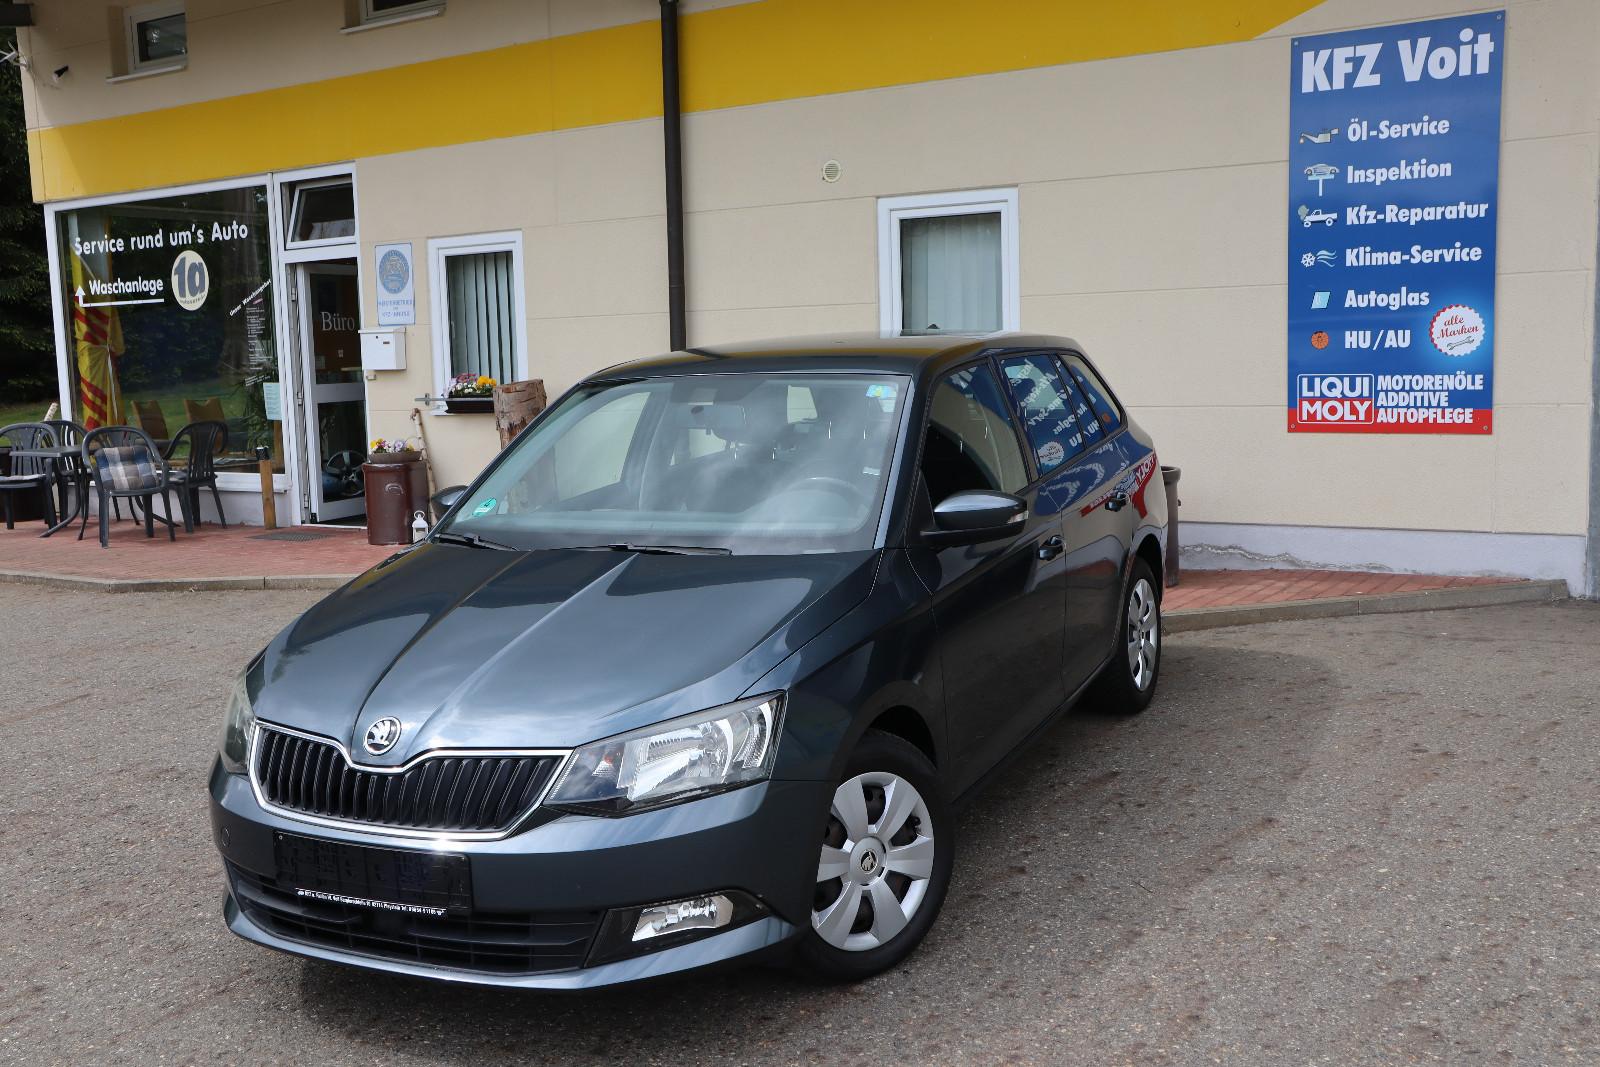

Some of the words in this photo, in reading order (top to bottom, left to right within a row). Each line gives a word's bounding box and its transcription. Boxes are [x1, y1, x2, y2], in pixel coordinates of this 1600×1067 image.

[1301, 42, 1384, 93] KFZ
[1397, 27, 1494, 82] Voit
[1347, 115, 1450, 142] Öl-Service
[1347, 158, 1452, 185] Inspektion
[1346, 201, 1489, 226] Kfz-Reparatur
[74, 234, 125, 256] Service
[130, 228, 164, 250] rund
[169, 224, 205, 246] um's
[211, 220, 248, 242] Auto
[1345, 241, 1482, 267] Klima-Service
[88, 275, 164, 297] Waschanlage
[1344, 286, 1430, 311] Autoglas
[321, 311, 355, 331] Büro
[1437, 324, 1479, 339] Marken
[1444, 314, 1465, 327] alle
[1301, 376, 1370, 399] LIQUI
[1376, 371, 1484, 391] MOTORENÖLE
[1376, 391, 1449, 407] ADDITIVE
[1301, 400, 1371, 421] MOLY
[1376, 407, 1474, 424] AUTOPFLEGE
